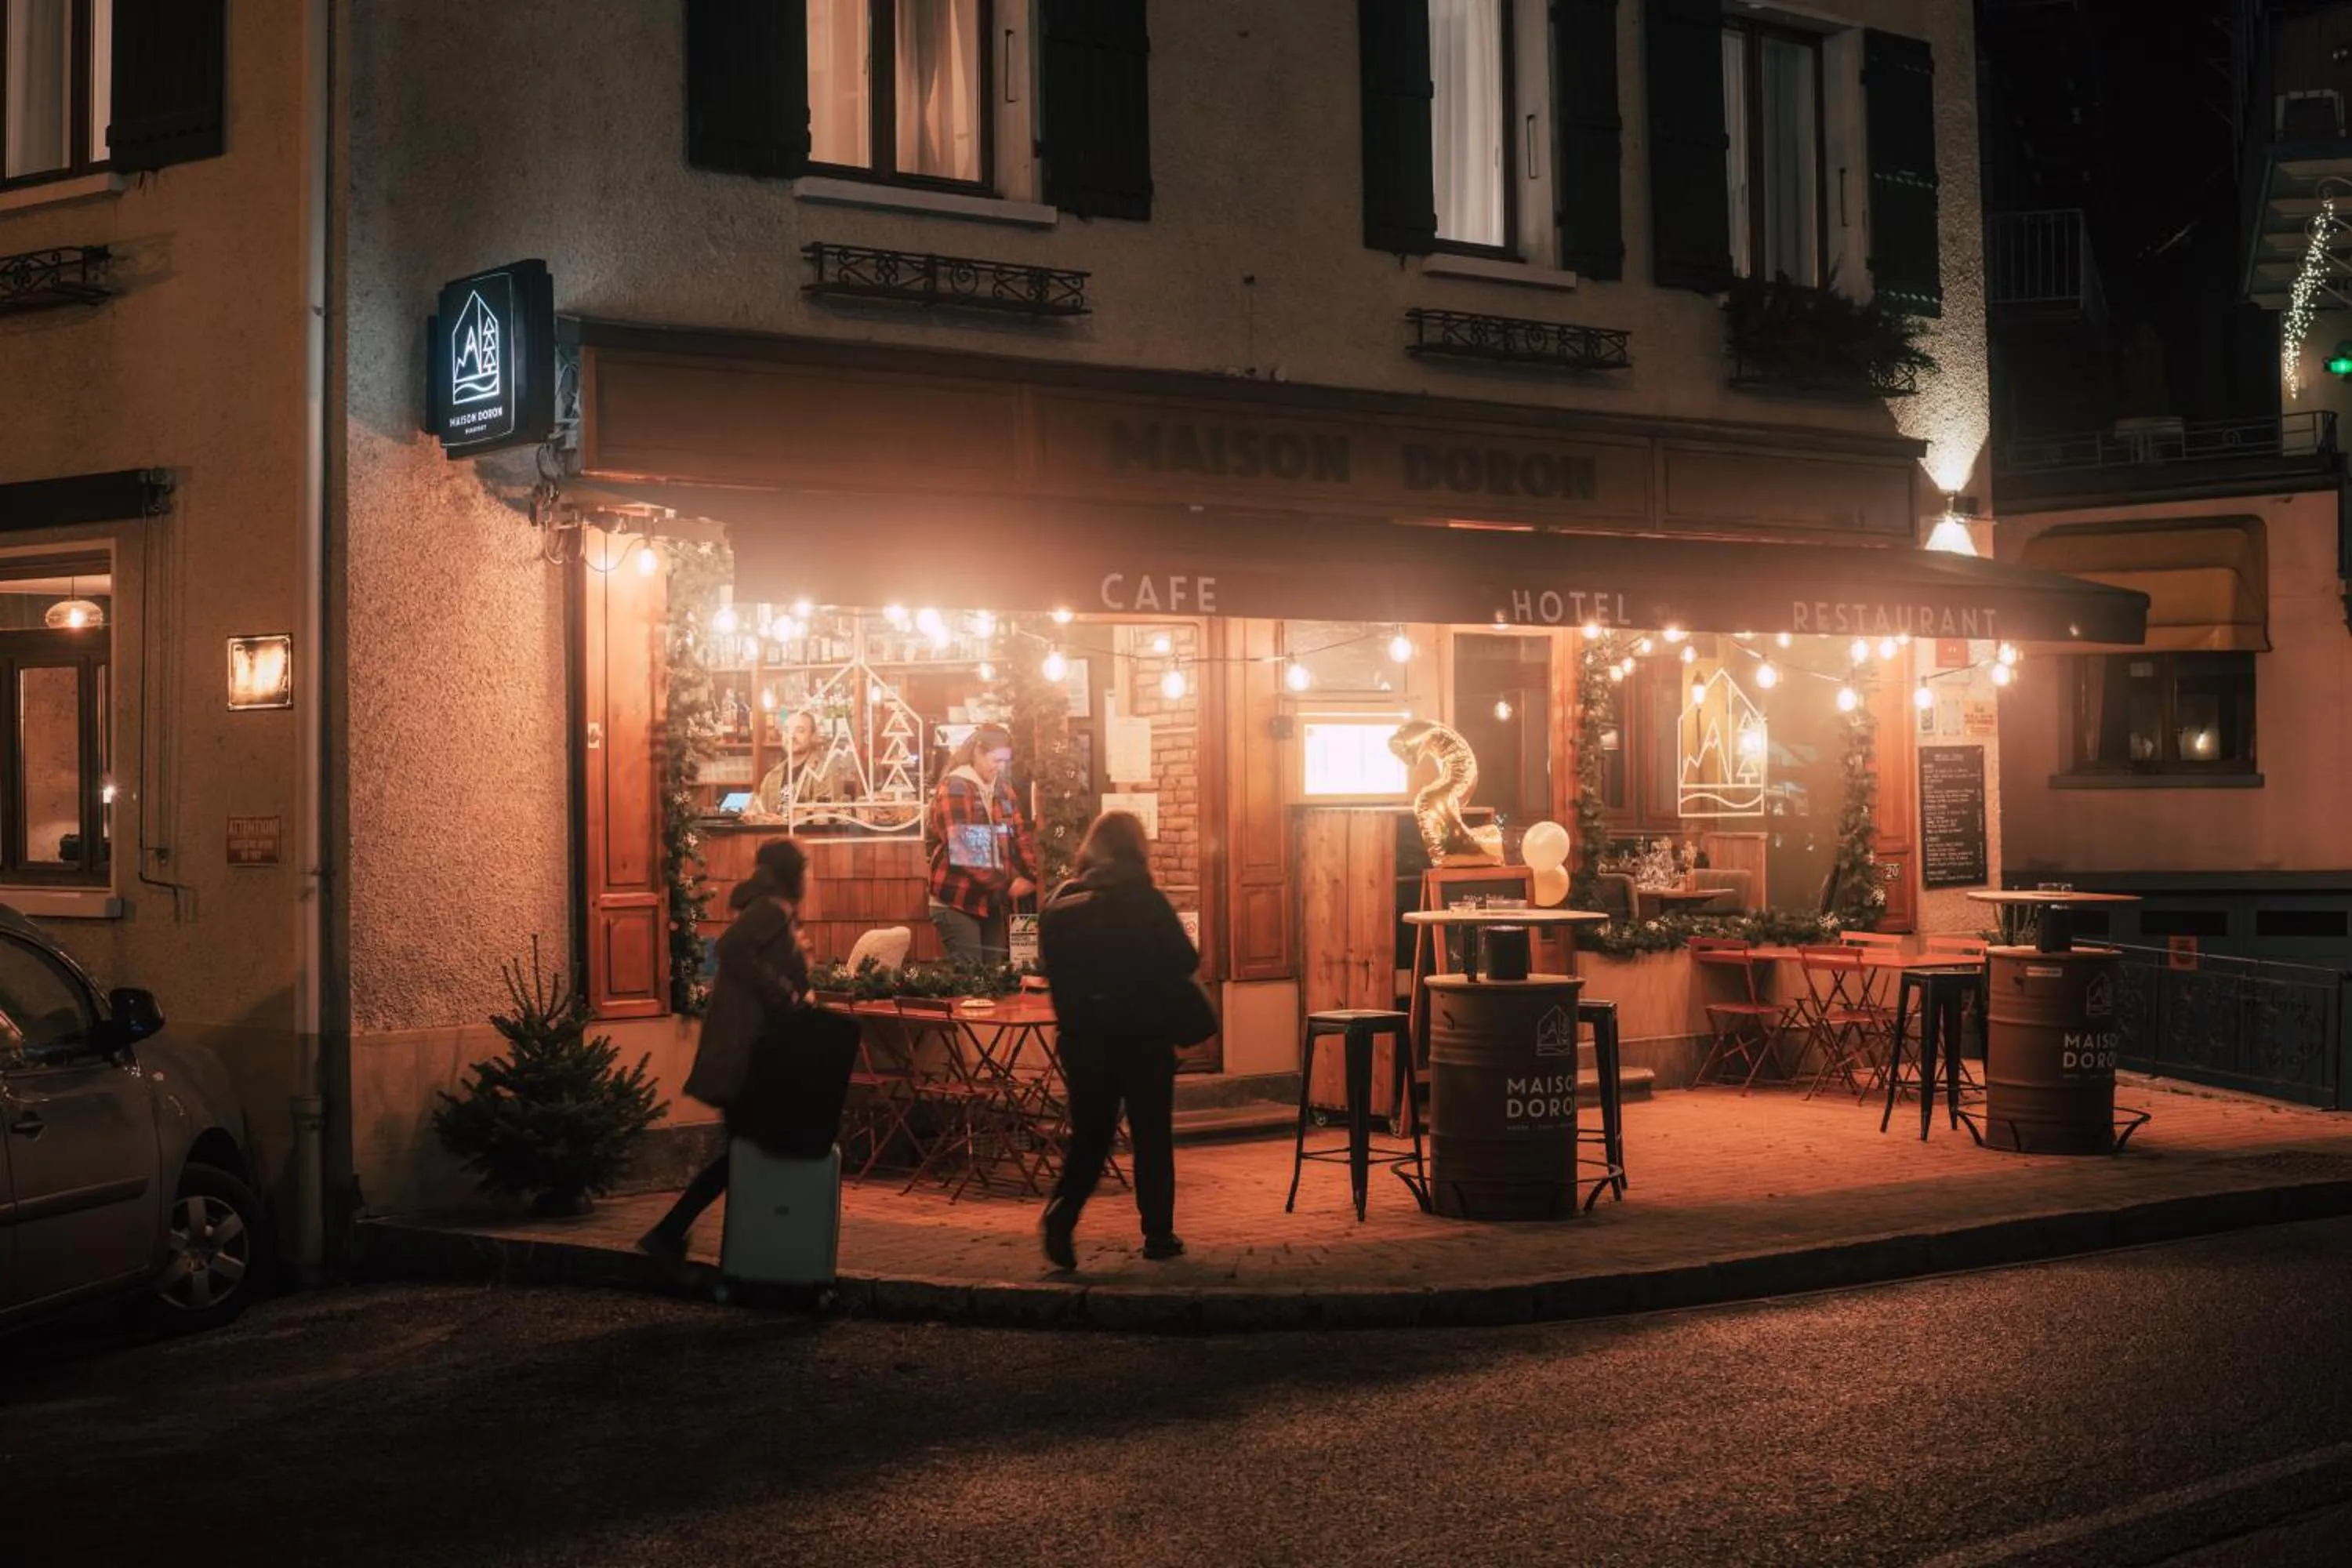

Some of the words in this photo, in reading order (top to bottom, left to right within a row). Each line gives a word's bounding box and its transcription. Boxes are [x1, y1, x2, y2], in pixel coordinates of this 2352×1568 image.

[449, 412, 477, 427] MAISON
[478, 405, 503, 421] DORON
[1108, 419, 1351, 483] MAISON
[1402, 443, 1596, 501] DORON
[1101, 572, 1217, 612] CAFE
[1512, 589, 1632, 625] HOTEL
[1793, 601, 1997, 637] RESTAURANT
